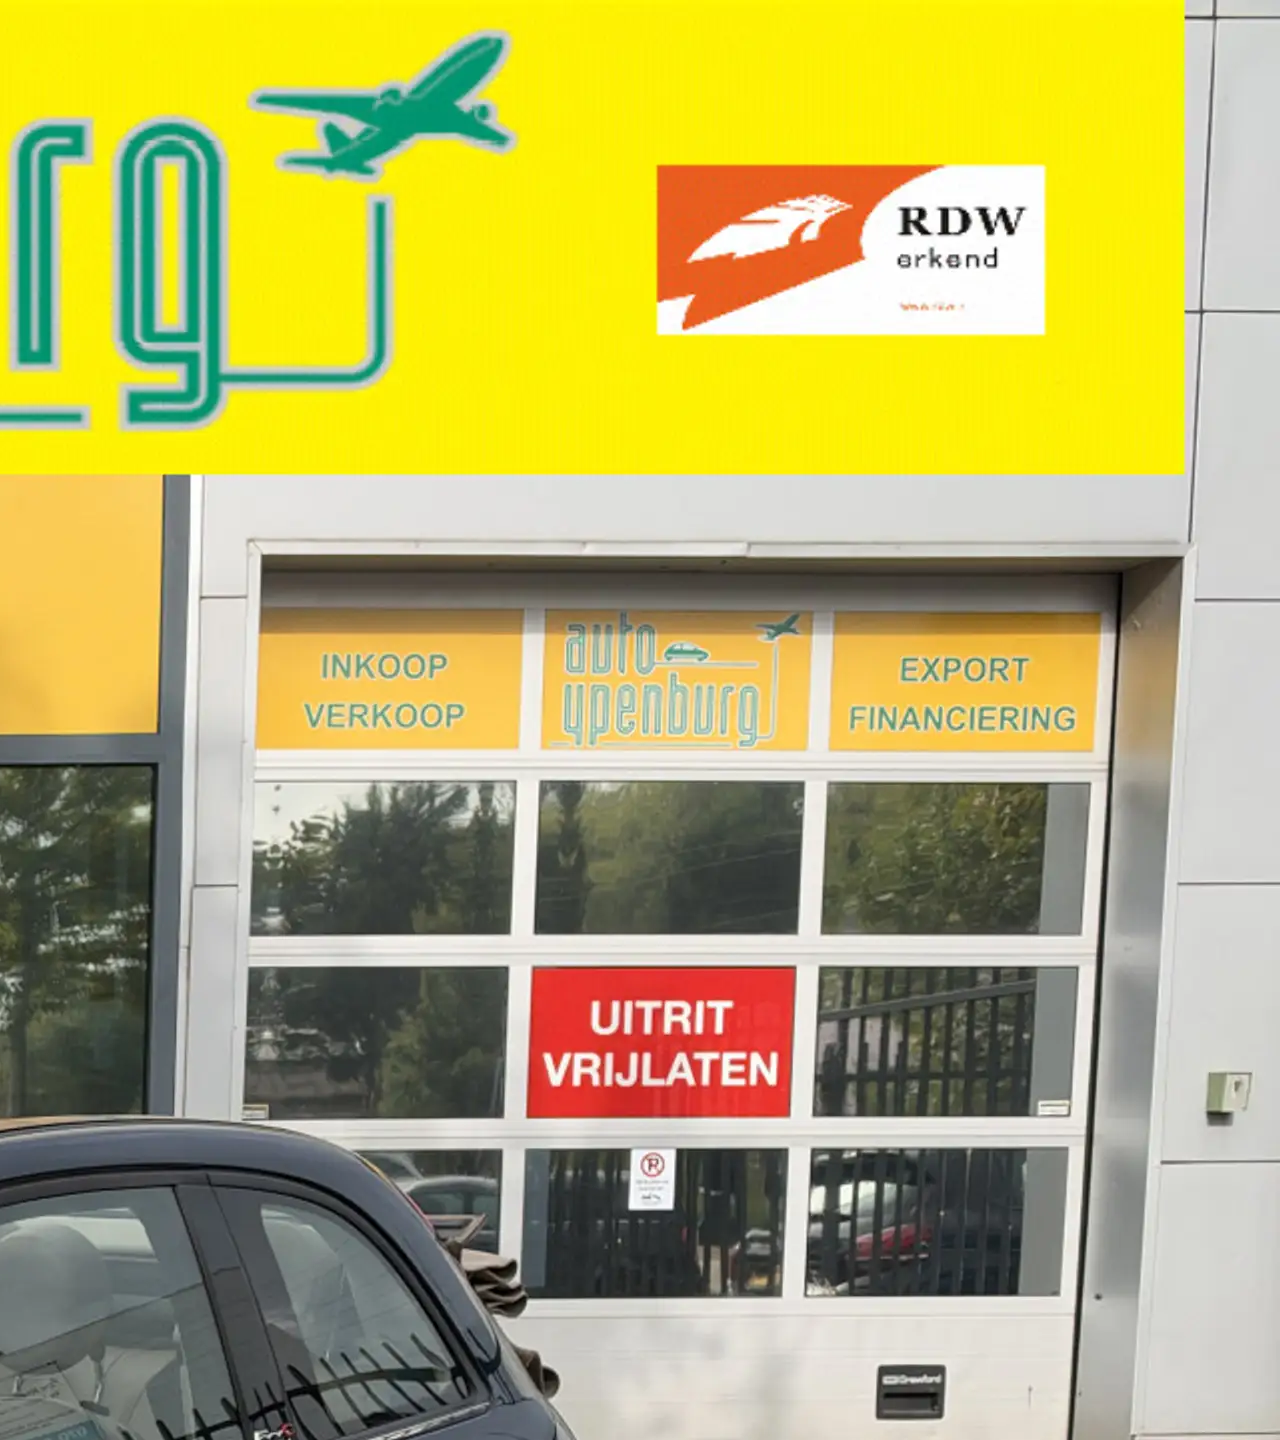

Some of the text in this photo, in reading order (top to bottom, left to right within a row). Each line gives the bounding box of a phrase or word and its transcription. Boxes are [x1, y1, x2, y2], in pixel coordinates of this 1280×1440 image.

[565, 611, 656, 675] auto
[321, 652, 448, 680] INKOOP
[899, 656, 1030, 683] EXPORT
[303, 702, 466, 729] VERKOOP
[564, 671, 759, 747] ypenburg
[849, 705, 1077, 732] FINANCIERING
[590, 1000, 734, 1036] UITRIT
[543, 1051, 779, 1088] VRIJLATEN
